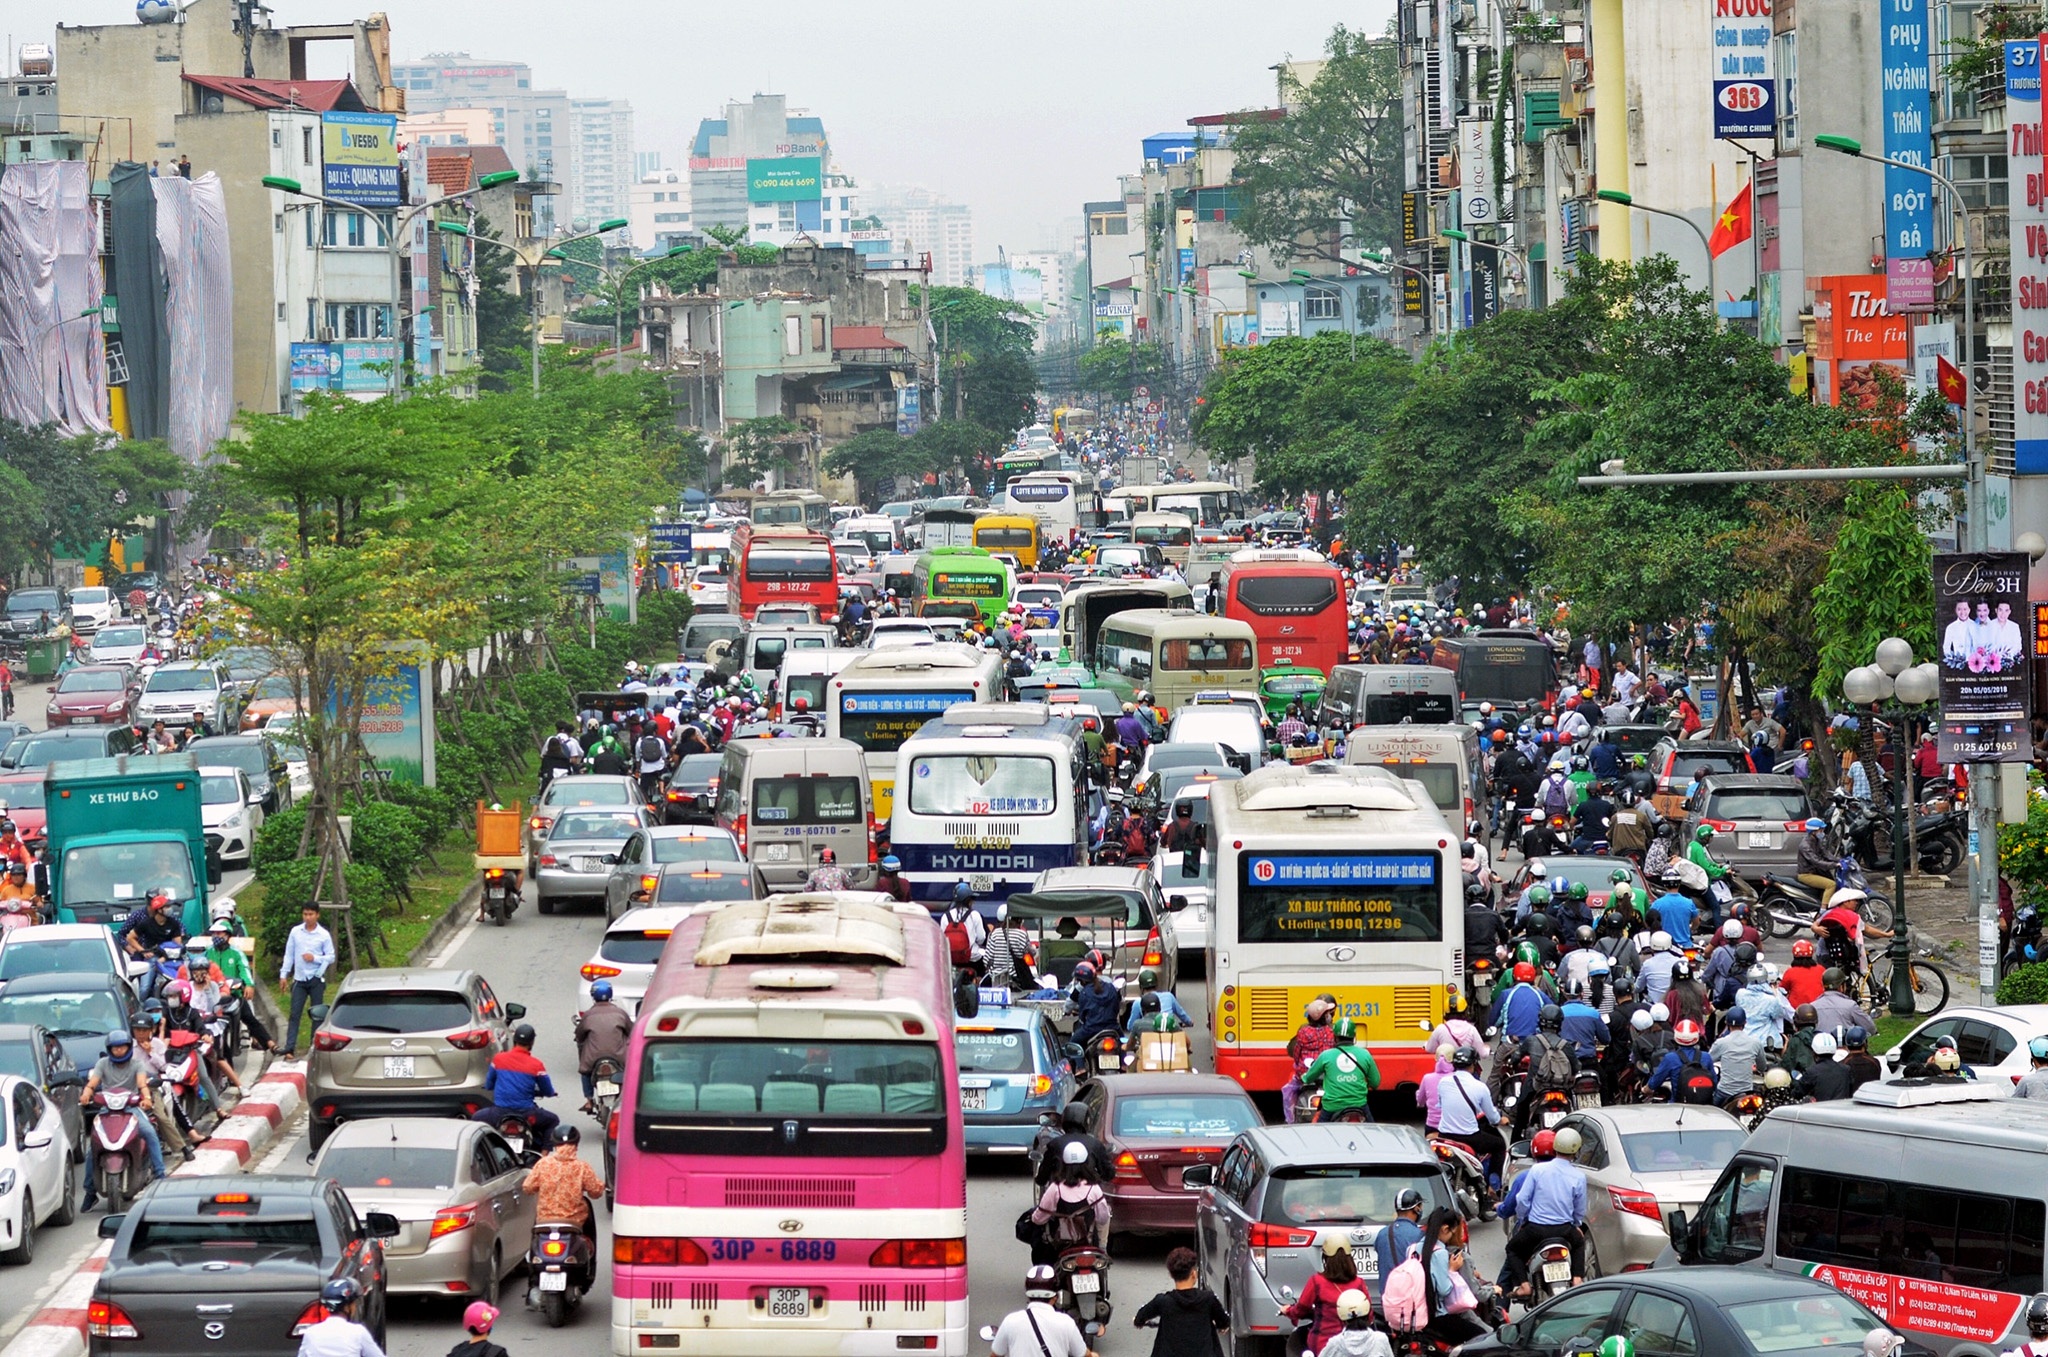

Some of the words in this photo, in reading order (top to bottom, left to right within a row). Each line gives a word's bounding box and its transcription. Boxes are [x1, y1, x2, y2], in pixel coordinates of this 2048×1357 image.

[1715, 25, 1738, 46] CÔNG
[1742, 25, 1771, 49] NGHIỆP
[1890, 25, 1920, 52] PHỤ
[1722, 53, 1740, 75] DÂN
[1743, 56, 1765, 77] DỤNG
[1884, 62, 1927, 90] NGÀNH
[1727, 87, 1760, 109] 363
[1893, 102, 1922, 134] TRẦN
[352, 134, 379, 148] VESBO
[776, 144, 817, 154] HDBank
[1473, 129, 1483, 163] LAW
[328, 171, 339, 186] ĐẠI
[352, 168, 378, 187] QUANG
[379, 169, 398, 186] NAM
[780, 178, 794, 187] 464
[796, 178, 816, 187] 6699
[1474, 166, 1484, 193] HQC
[2027, 174, 2044, 212] Bị
[1893, 188, 1926, 217] BỘT
[1900, 223, 1921, 248] BẢ
[2026, 225, 2048, 264] Vệ
[1899, 262, 1927, 273] 371
[1407, 278, 1418, 288] NỘI
[1485, 270, 1493, 301] BANK
[1405, 290, 1420, 299] THẤT
[2019, 276, 2048, 309] Sin
[1846, 329, 1873, 343] The
[2024, 330, 2048, 363] Ca
[1943, 561, 1996, 596] Đêm
[1996, 578, 2021, 593] 3H
[767, 582, 781, 592] 29B
[787, 582, 811, 592] 127.27
[1973, 686, 2008, 694] 05/05/2018
[846, 701, 856, 710] 24
[1368, 743, 1443, 751] LIMOUSINE
[1954, 743, 1977, 751] 0125
[1996, 742, 2018, 751] 9651
[90, 793, 104, 805] XE
[107, 792, 130, 803] THƯ
[132, 788, 159, 801] BÁO
[973, 802, 989, 814] 02
[932, 855, 1034, 869] HYUNDAI
[1257, 864, 1272, 878] 16
[975, 876, 989, 884] 29U
[1305, 901, 1324, 913] BUS
[1326, 897, 1362, 913] THĂNG
[1364, 900, 1392, 913] LONG
[1288, 920, 1326, 930] Hotline
[1329, 918, 1402, 930] 1900.1296
[1337, 1075, 1358, 1083] Grab
[963, 1089, 979, 1098] 30A
[712, 1239, 756, 1261] 30P
[780, 1240, 837, 1261] 6889
[1838, 1271, 1861, 1284] TRƯỜNG
[1862, 1274, 1875, 1286] LIÊN
[1876, 1274, 1888, 1288] CẤP
[777, 1290, 800, 1302] 30P
[1857, 1289, 1869, 1302] HỌC
[1872, 1291, 1888, 1303] THCS
[773, 1303, 805, 1316] 6889
[1909, 1299, 1923, 1310] (024)
[1924, 1301, 1937, 1311] 6287
[1938, 1303, 1951, 1314] 2079
[1952, 1305, 1965, 1316] (Tiểu
[1965, 1308, 1977, 1319] học)
[1909, 1316, 1923, 1327] (024)
[1923, 1318, 1937, 1328] 6289
[1937, 1320, 1951, 1330] 4190
[1969, 1326, 1978, 1336] học
